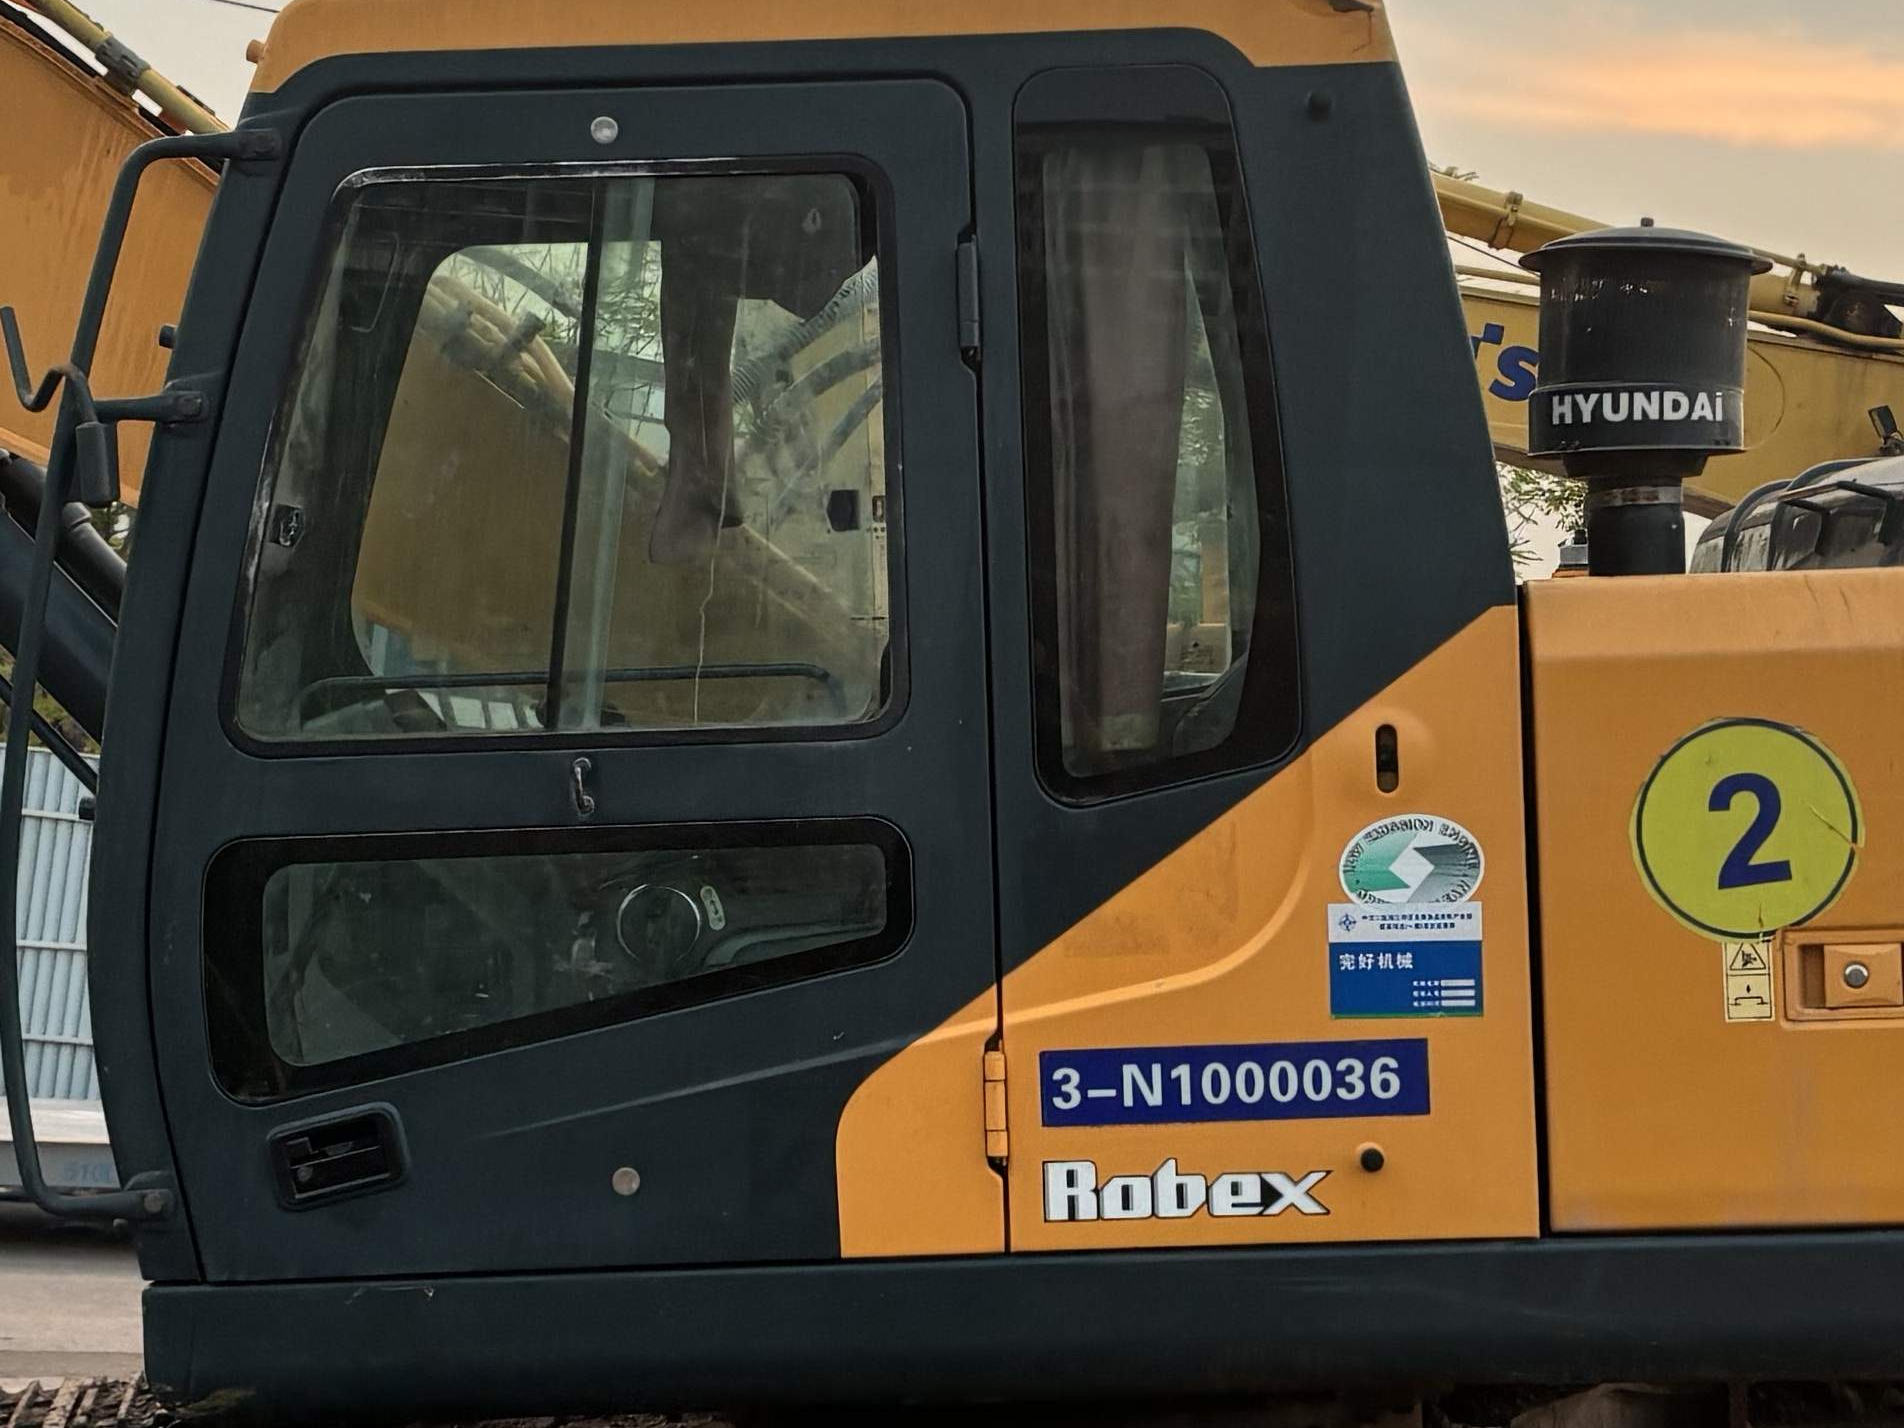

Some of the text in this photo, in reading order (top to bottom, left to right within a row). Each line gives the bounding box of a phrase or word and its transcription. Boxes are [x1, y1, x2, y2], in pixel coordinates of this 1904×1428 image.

[1707, 773, 1792, 890] 2
[1051, 1056, 1402, 1110] 3-N1000036
[1043, 1158, 1333, 1223] Robex
